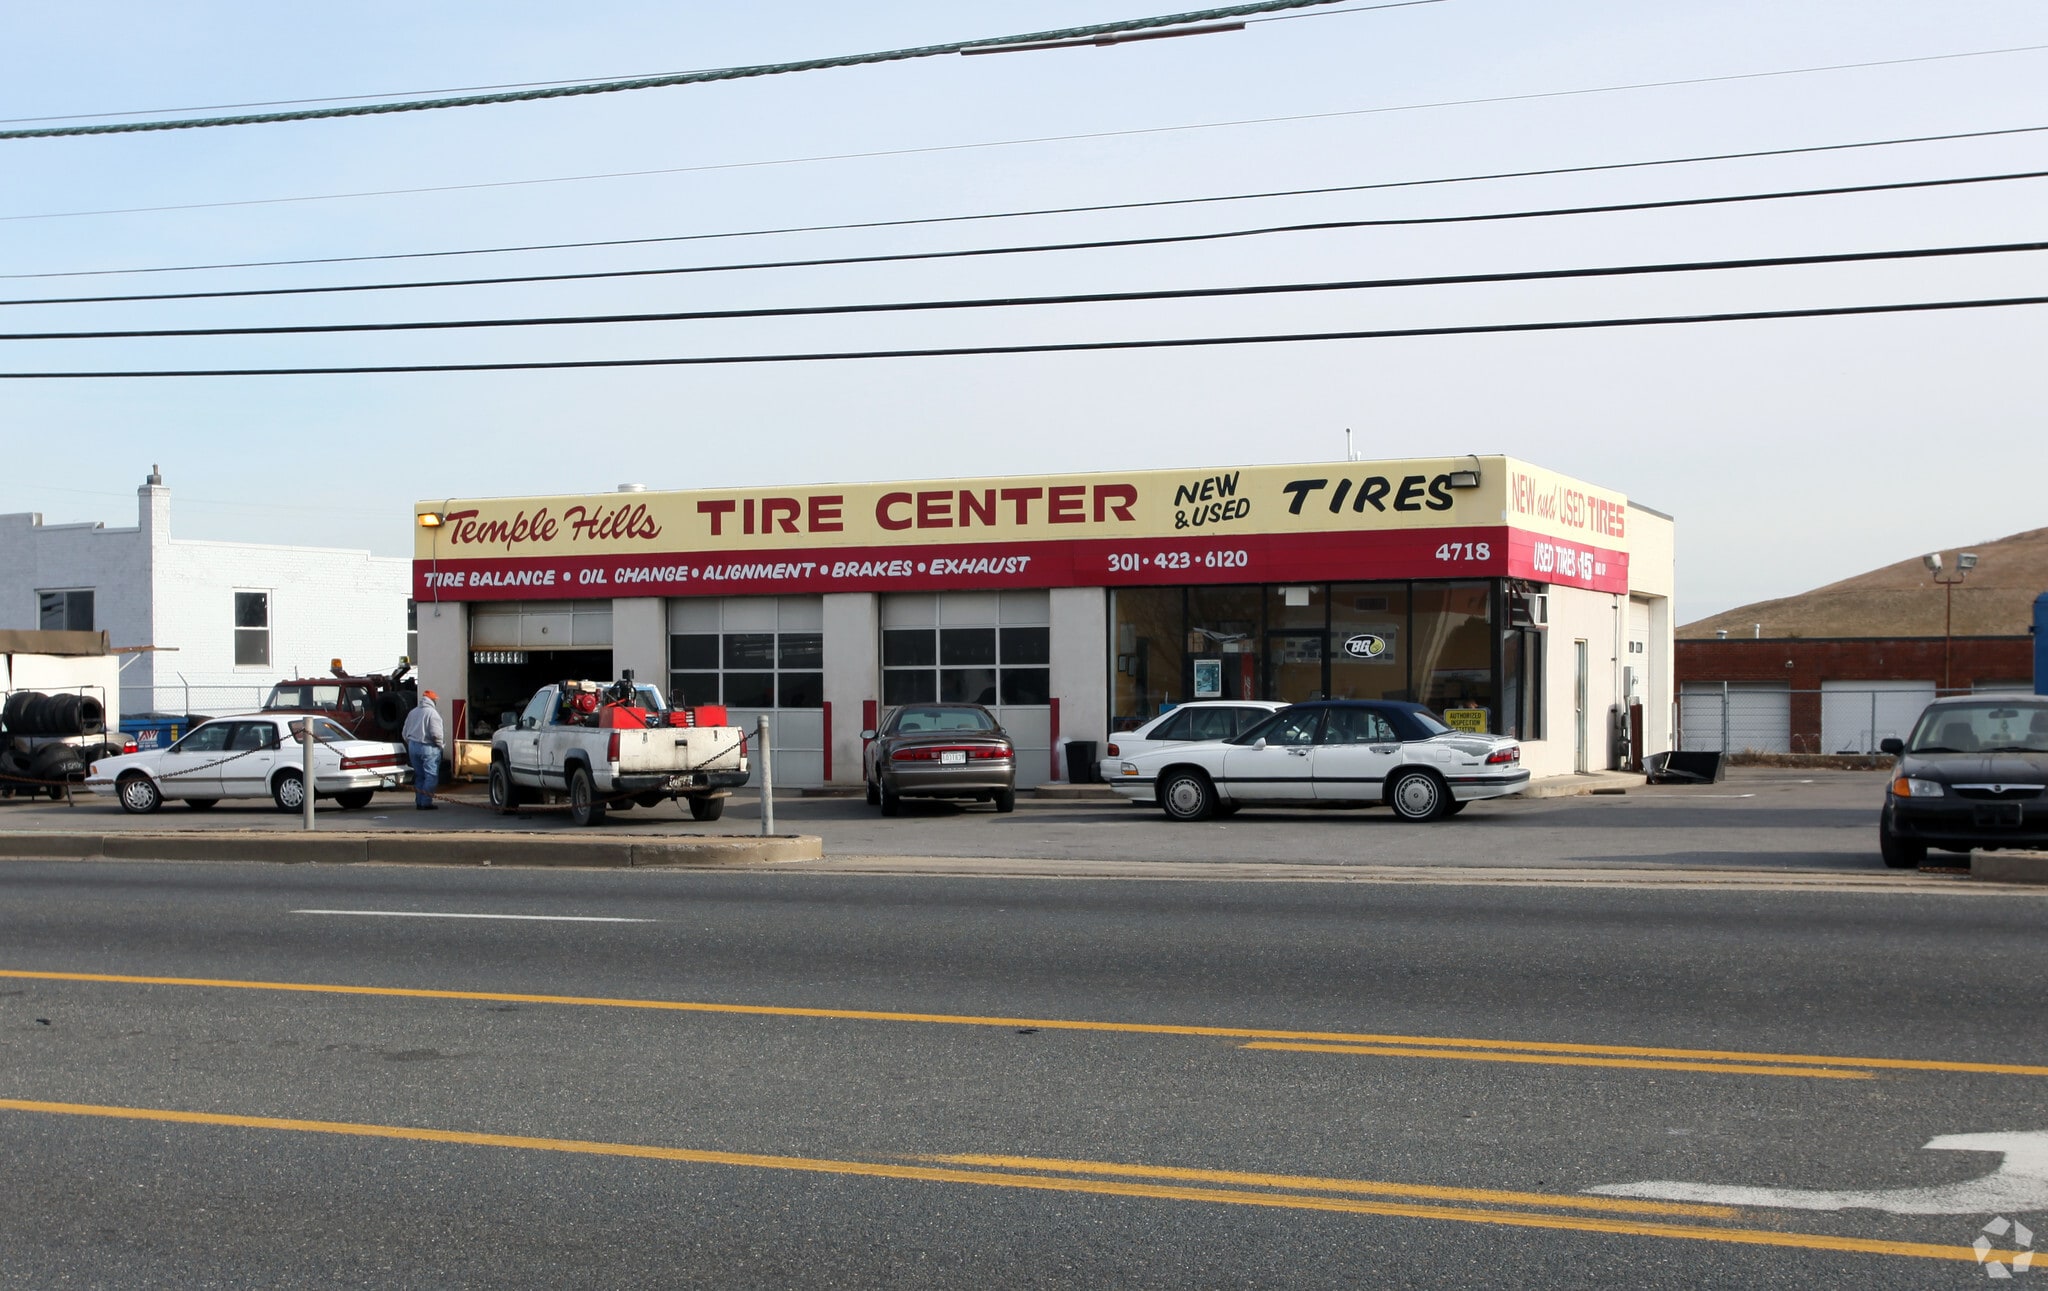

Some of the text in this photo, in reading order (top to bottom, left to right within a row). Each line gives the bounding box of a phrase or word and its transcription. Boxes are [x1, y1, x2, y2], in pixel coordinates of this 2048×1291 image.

[1174, 471, 1240, 506] NEW
[1282, 474, 1454, 515] TIRES
[1512, 472, 1536, 516] NEW
[1559, 487, 1585, 528] USED
[1587, 496, 1625, 538] TIRES
[446, 503, 662, 551] Temple Hills
[697, 483, 1138, 536] TIRE CENTER
[1435, 543, 1490, 561] 4718
[1533, 541, 1554, 573] USED
[1555, 546, 1576, 577] TIRES
[423, 556, 1031, 588] TIRE BALANCE OIL CHANGE ALIGNMENT BRAKES EXHAUST
